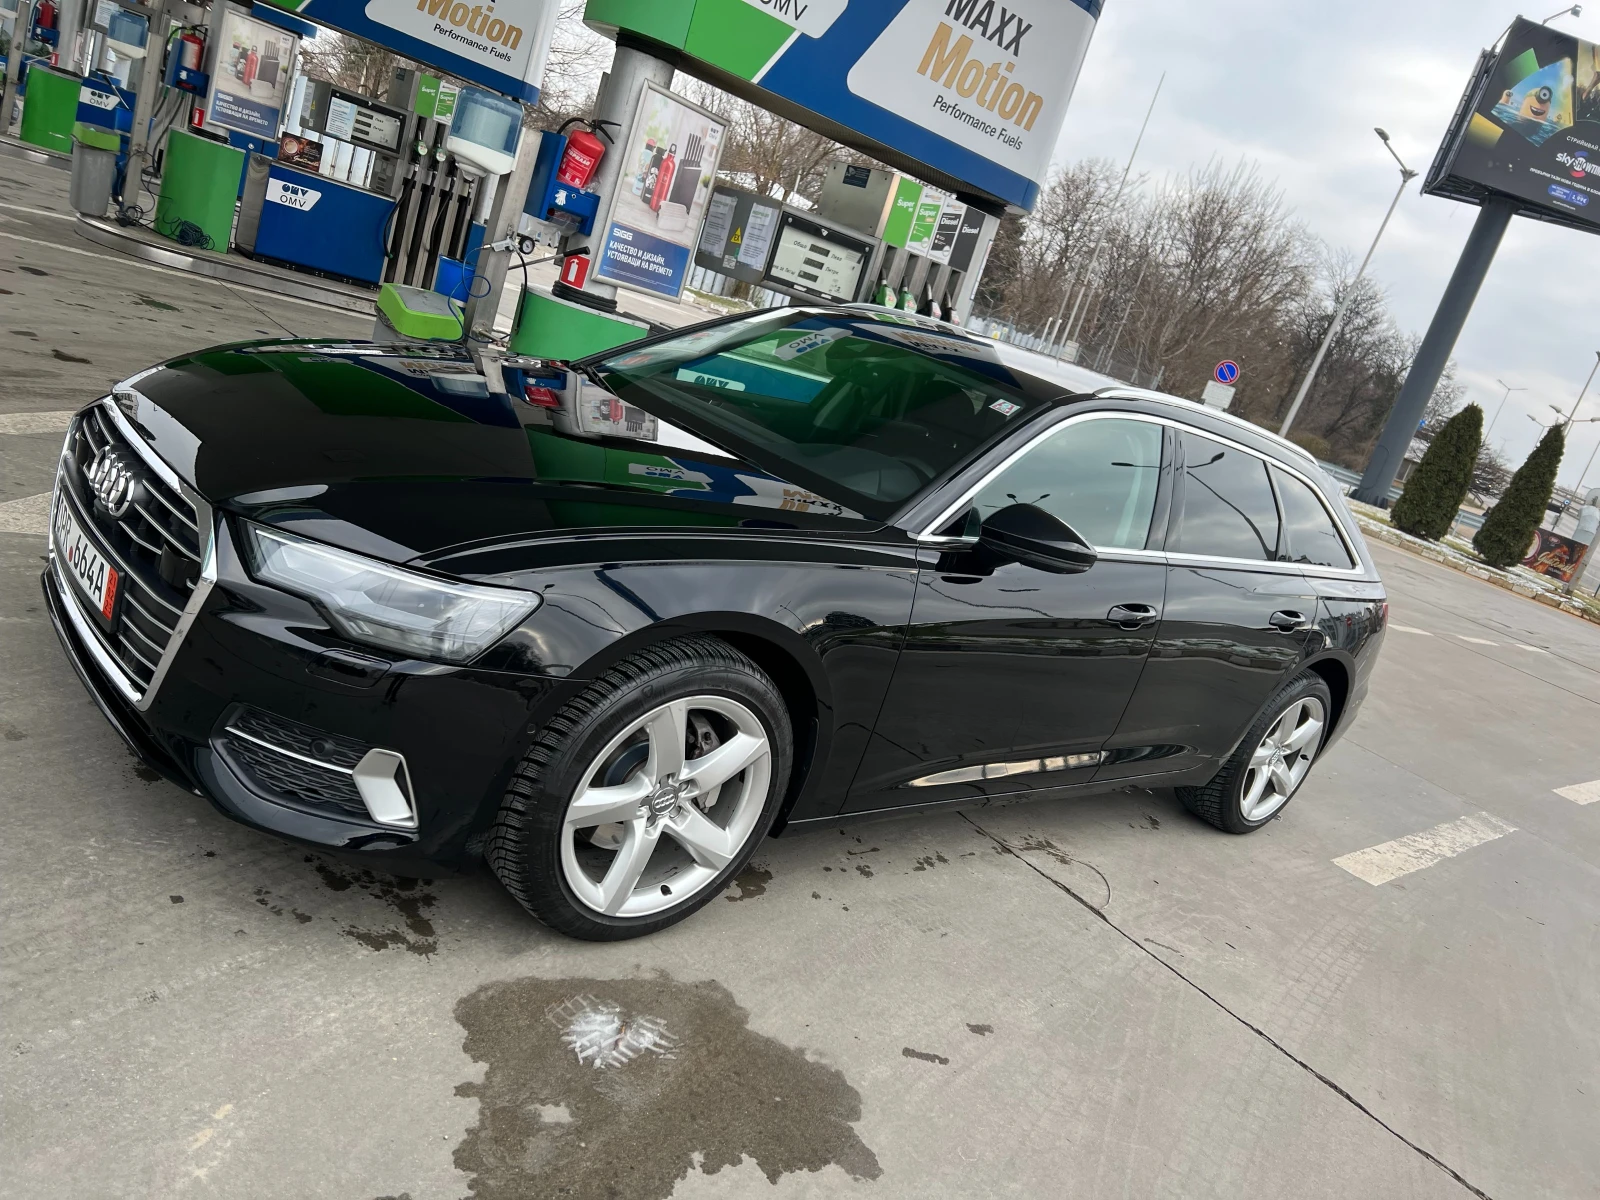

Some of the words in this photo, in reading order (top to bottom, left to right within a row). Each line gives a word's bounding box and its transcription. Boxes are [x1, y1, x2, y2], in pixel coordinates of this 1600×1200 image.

[760, 0, 808, 20] MV
[944, 0, 1033, 57] MAXX
[433, 23, 488, 52] Performance
[489, 46, 512, 62] Fuels
[916, 21, 1044, 132] Motion
[89, 97, 109, 108] OMV
[932, 94, 997, 137] Performance
[997, 127, 1023, 151] Fuels
[280, 194, 307, 208] OMV
[896, 199, 915, 208] Super
[919, 208, 937, 217] Super
[612, 227, 634, 241] SIGG
[607, 249, 641, 268] УСТОЯВАЩИ
[640, 262, 649, 270] НА
[648, 264, 673, 277] ВРЕМЕТО
[609, 240, 638, 257] КАЧЕСТВО
[641, 251, 665, 266] ДИЗАЙН,
[73, 534, 105, 603] 664A
